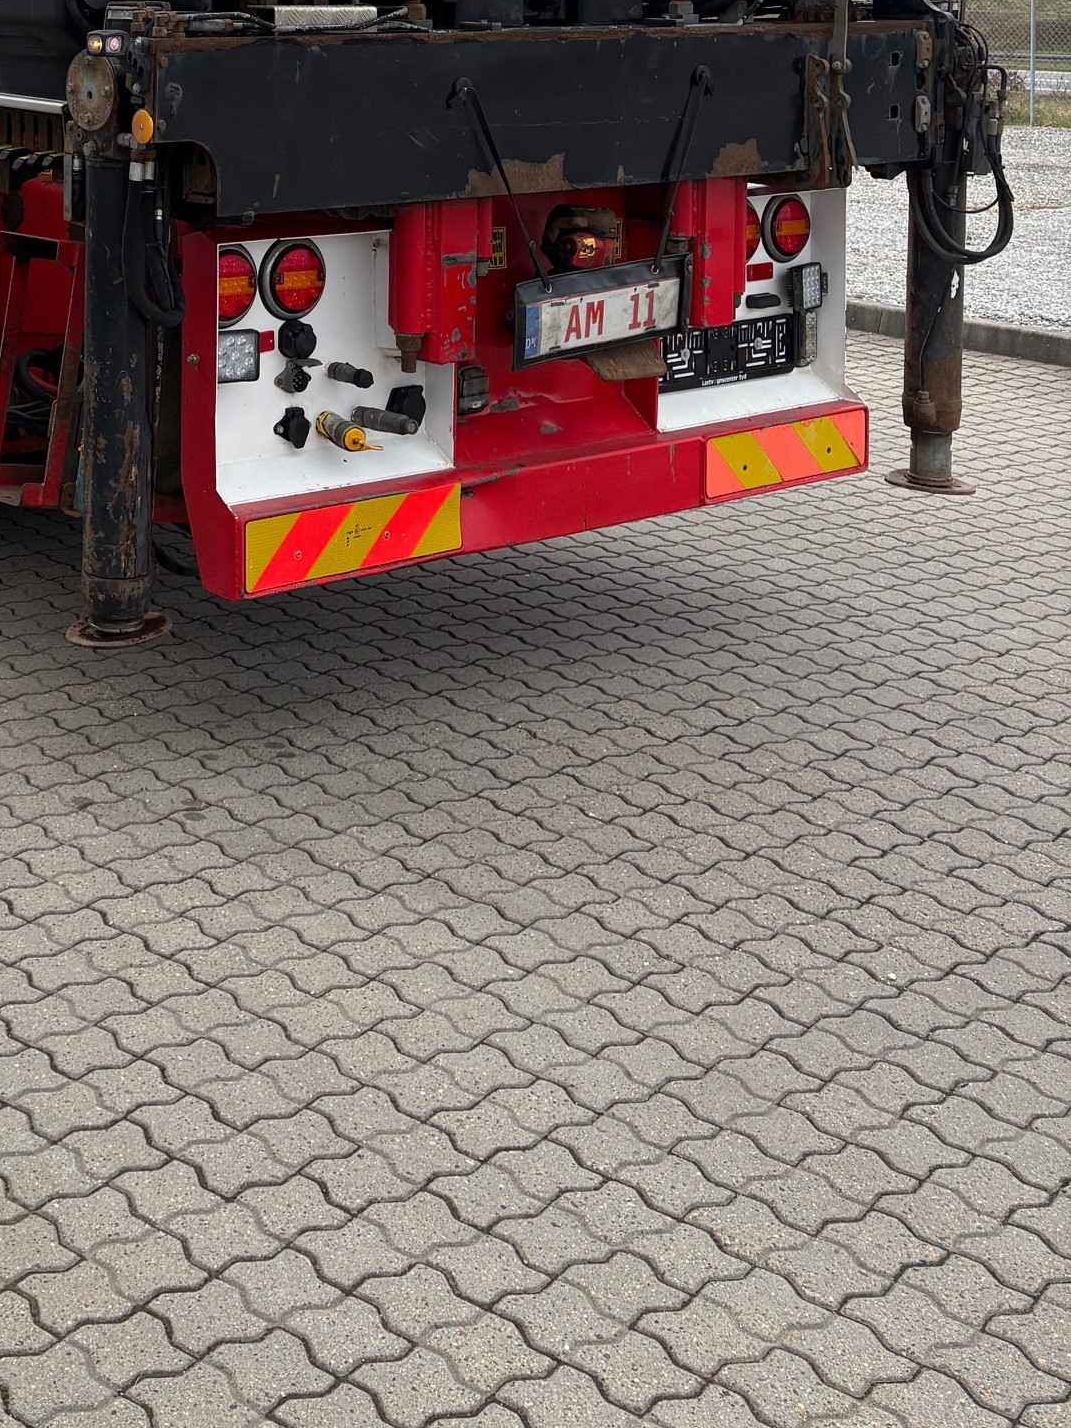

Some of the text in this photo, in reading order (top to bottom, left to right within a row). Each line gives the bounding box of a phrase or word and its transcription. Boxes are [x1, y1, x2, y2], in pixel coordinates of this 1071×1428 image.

[564, 290, 656, 343] AM 11
[526, 336, 537, 348] DK
[701, 375, 738, 386] Lastvgnscenter
